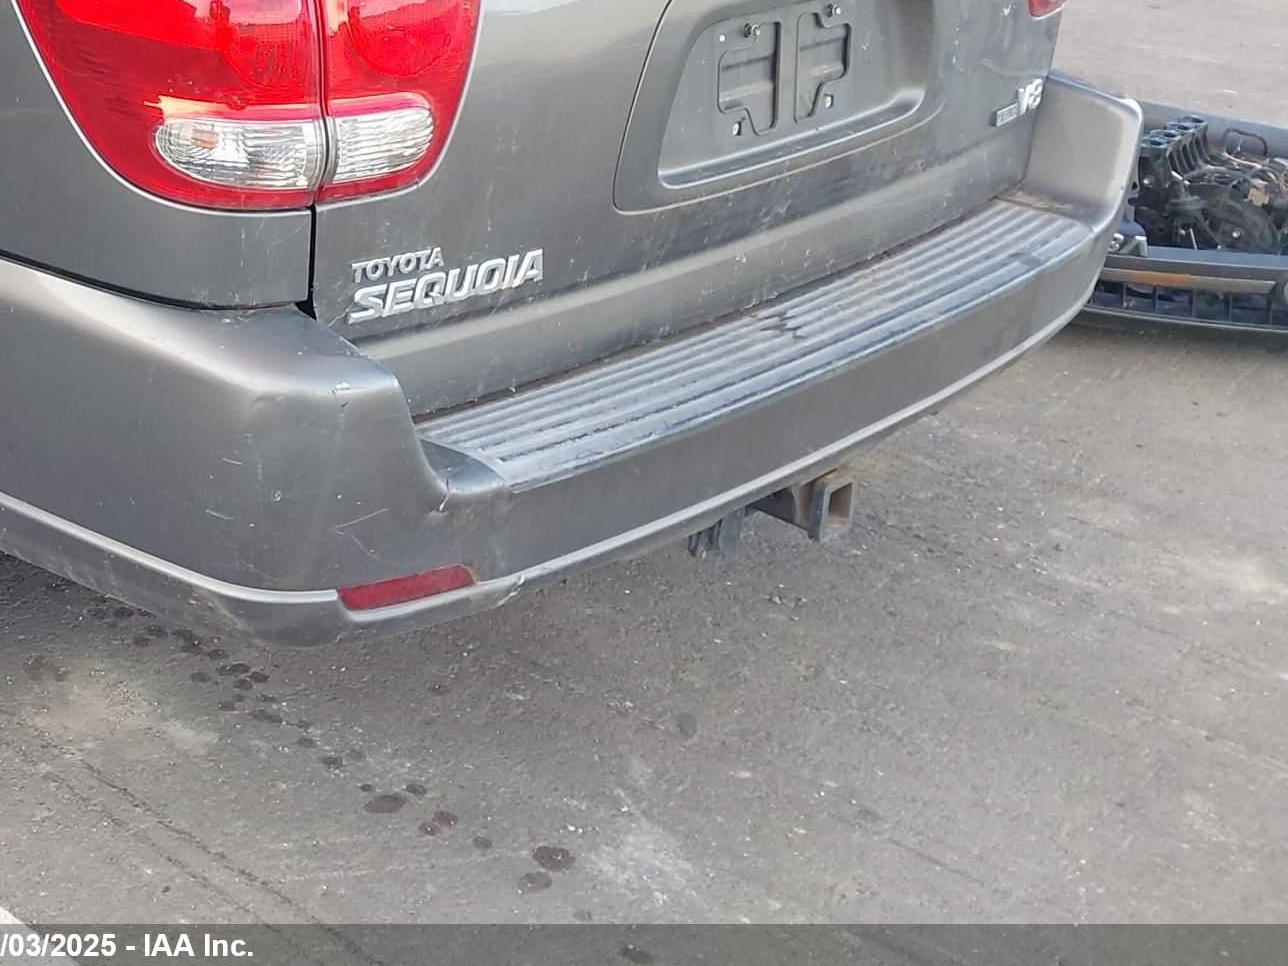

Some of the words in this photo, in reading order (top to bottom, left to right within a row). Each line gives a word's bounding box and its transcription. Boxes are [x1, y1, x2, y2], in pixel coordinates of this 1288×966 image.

[1017, 77, 1044, 116] V8
[351, 247, 445, 284] TOYOTA
[346, 247, 545, 325] SEQUOIA
